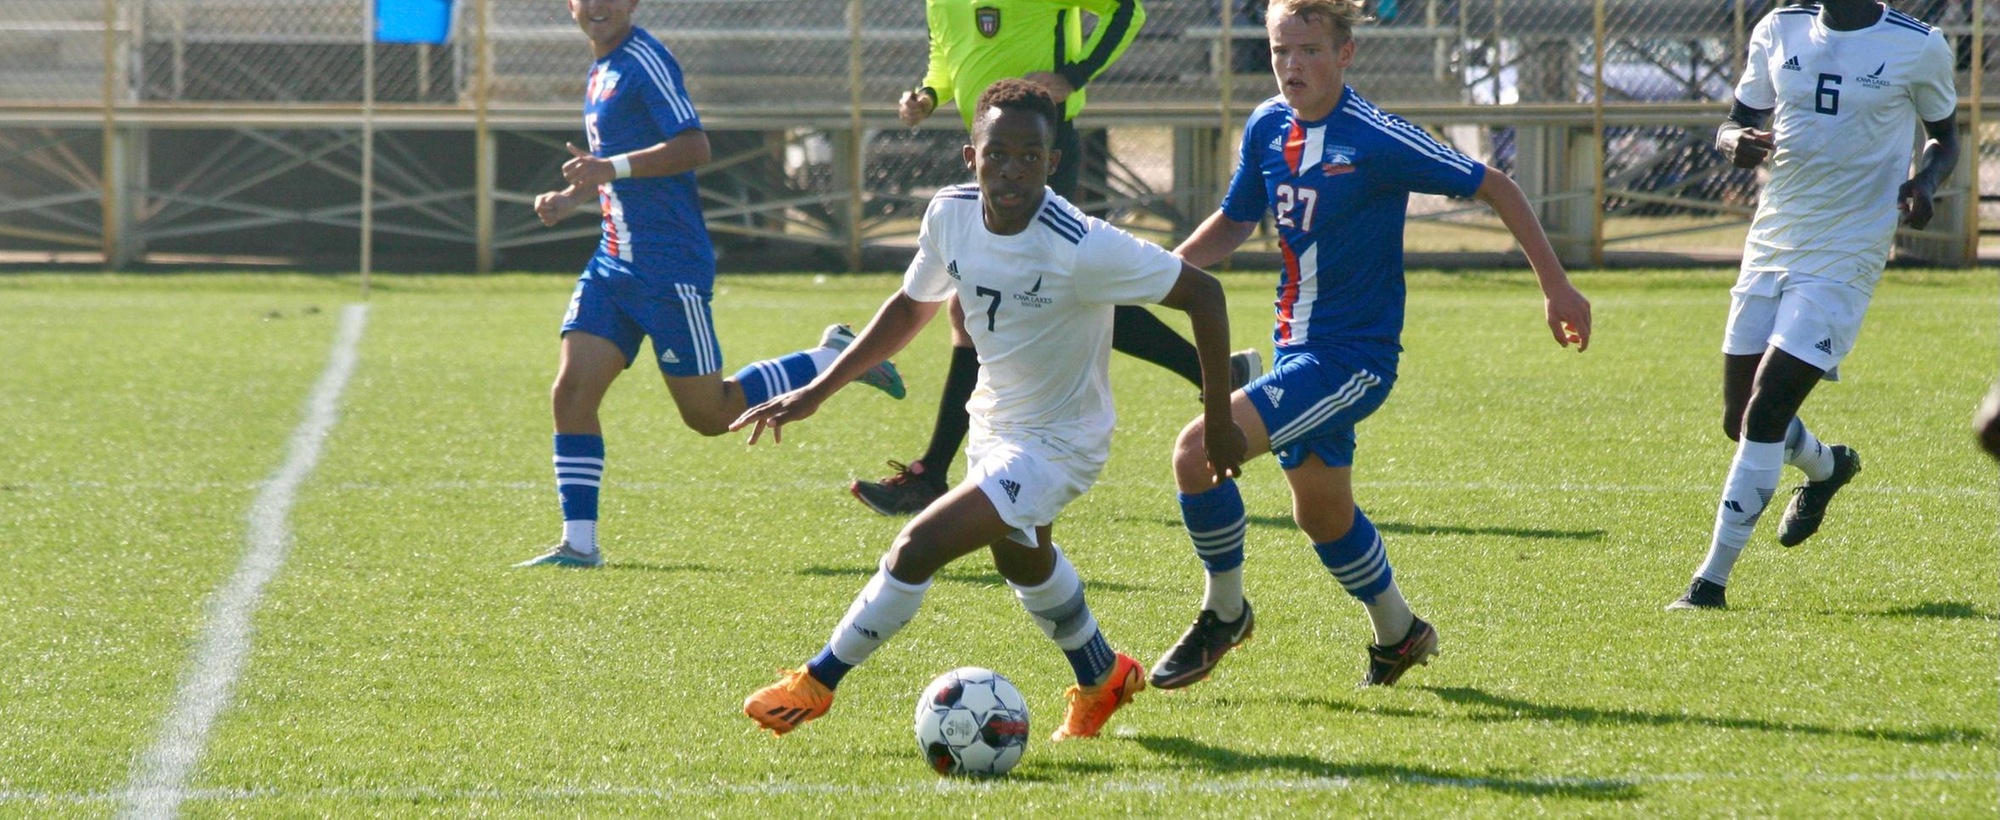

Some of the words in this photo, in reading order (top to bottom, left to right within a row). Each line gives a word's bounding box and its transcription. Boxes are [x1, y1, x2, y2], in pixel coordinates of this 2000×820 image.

[1815, 73, 1842, 116] 6
[1872, 79, 1890, 87] LAKES
[1276, 184, 1317, 232] 27
[976, 285, 1002, 332] 7
[1013, 293, 1030, 302] IOWA
[1031, 296, 1053, 304] LAKES
[999, 479, 1017, 504] adidas
